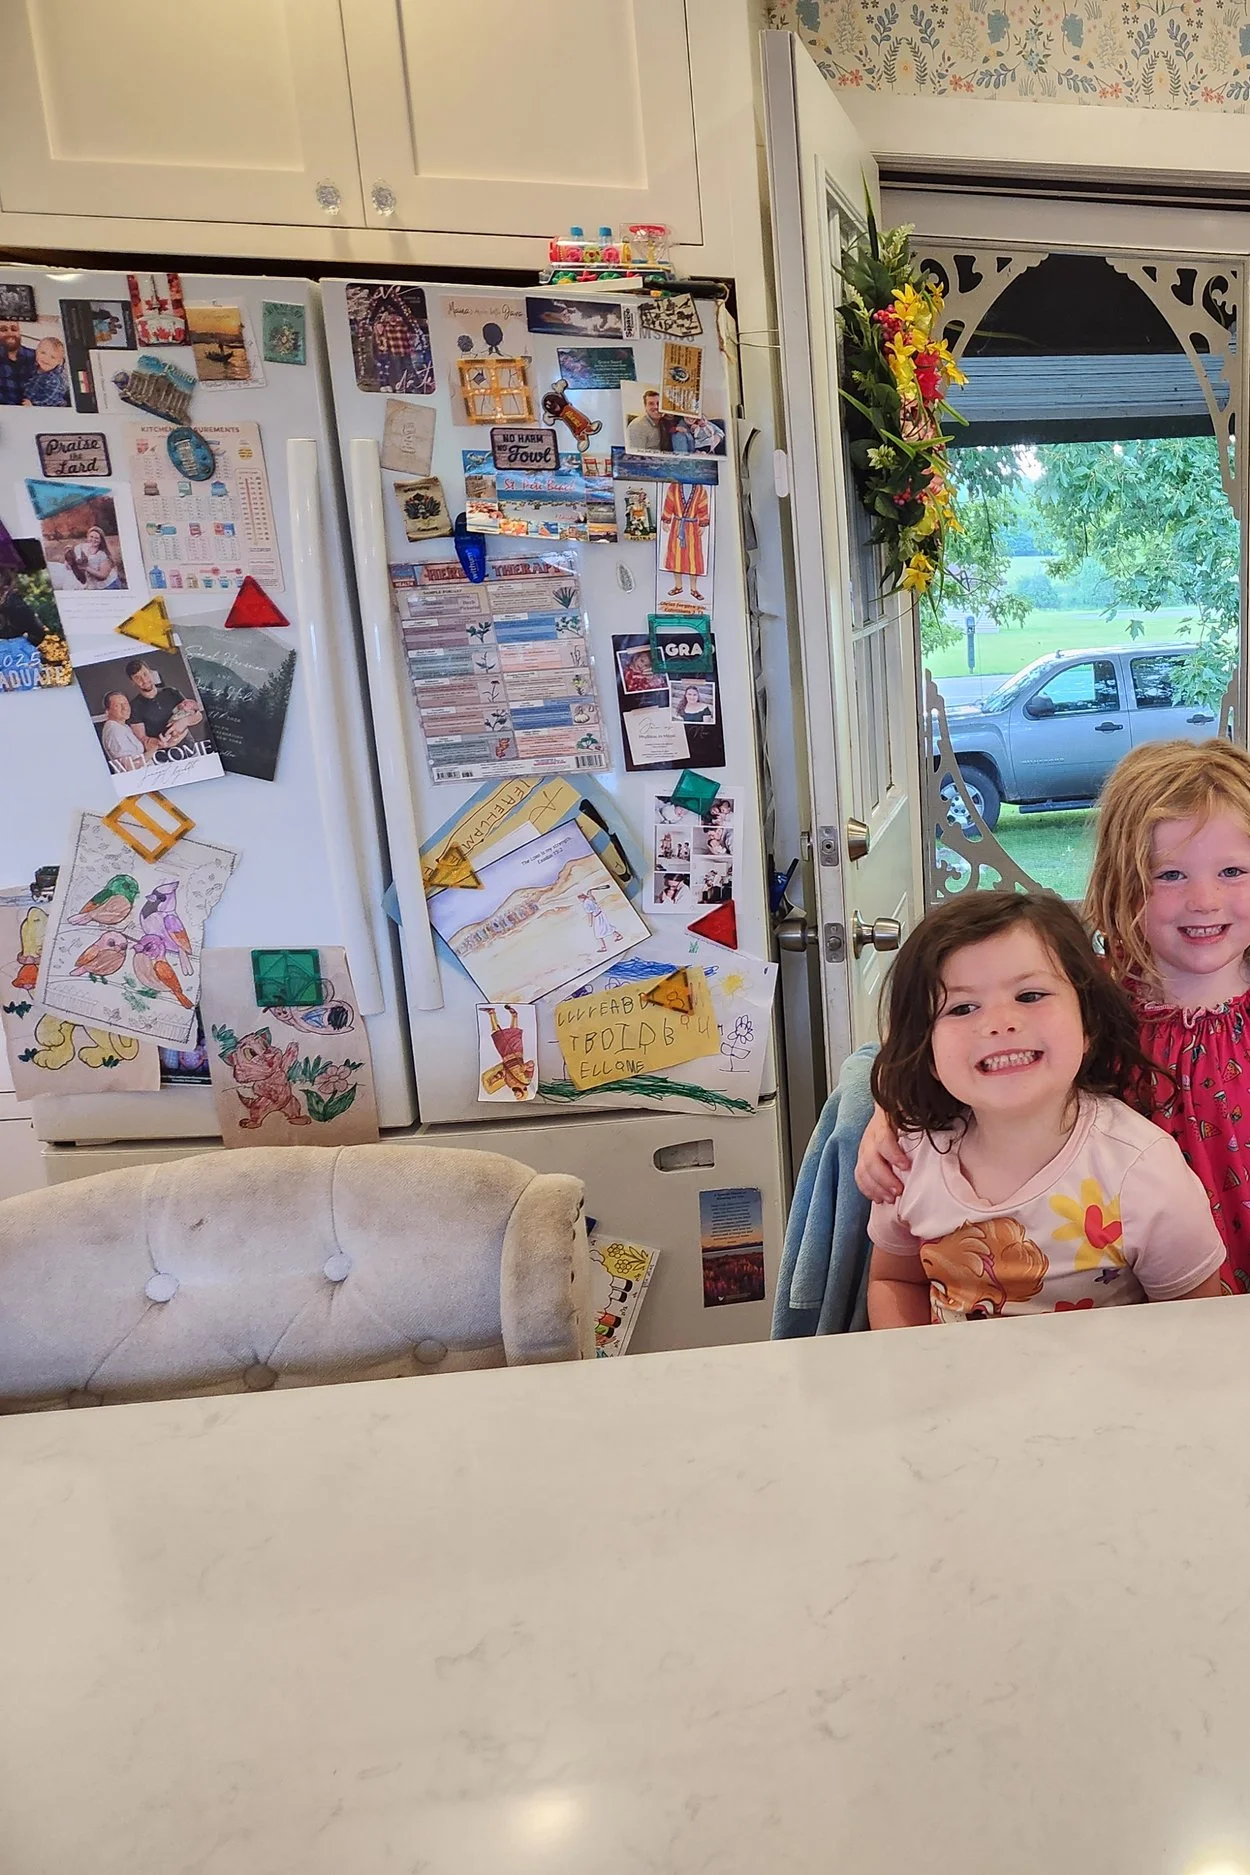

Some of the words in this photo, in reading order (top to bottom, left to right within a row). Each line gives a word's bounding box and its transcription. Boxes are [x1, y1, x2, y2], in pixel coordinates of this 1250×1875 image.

[624, 307, 633, 337] Space
[46, 436, 101, 455] Praise
[502, 434, 515, 443] NO
[518, 434, 543, 443] HARM
[508, 445, 551, 463] Fowl
[55, 459, 99, 475] Lard
[545, 479, 577, 491] Beach
[109, 740, 213, 773] WELCOME
